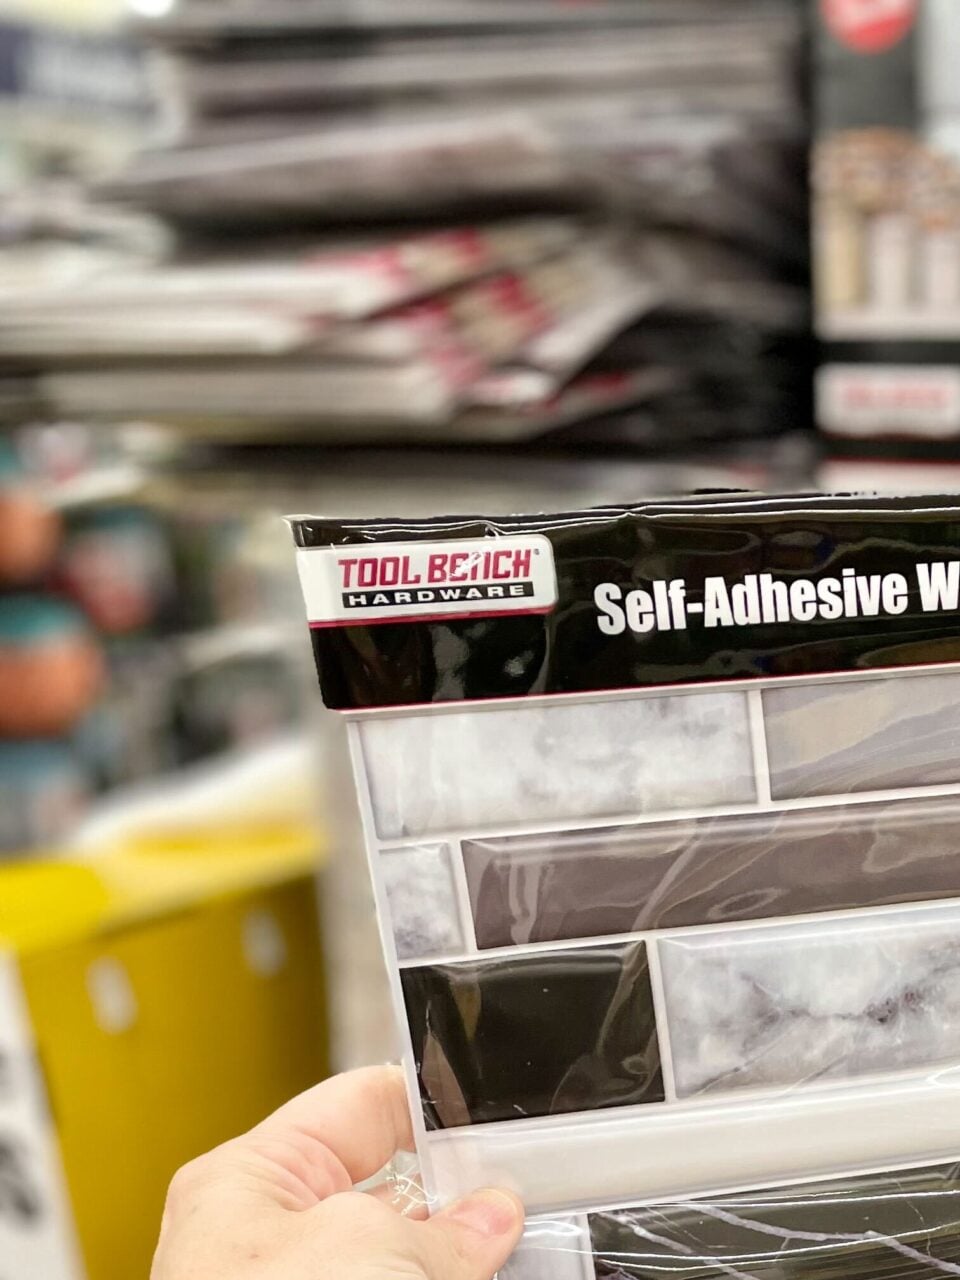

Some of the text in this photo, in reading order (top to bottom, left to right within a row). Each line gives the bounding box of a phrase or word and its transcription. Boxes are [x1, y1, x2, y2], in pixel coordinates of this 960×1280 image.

[338, 555, 421, 588] TOOL
[349, 584, 525, 607] HARDWARE
[594, 568, 908, 635] Self-Adhesive
